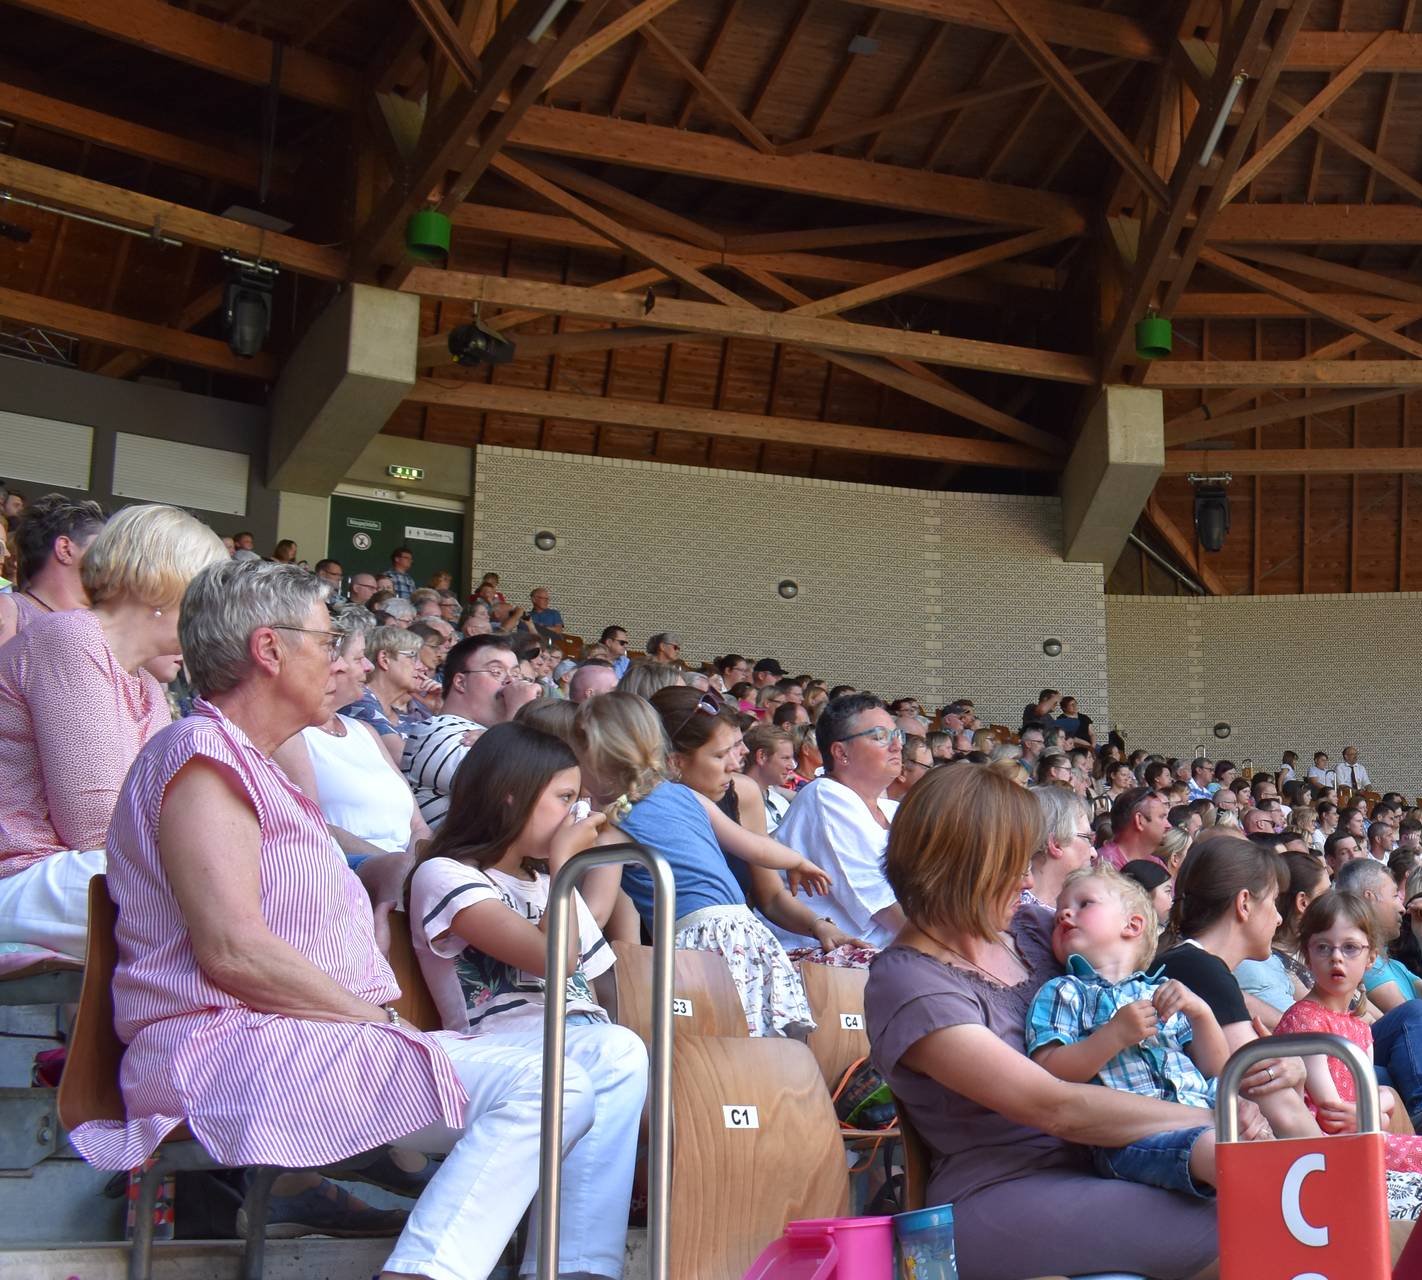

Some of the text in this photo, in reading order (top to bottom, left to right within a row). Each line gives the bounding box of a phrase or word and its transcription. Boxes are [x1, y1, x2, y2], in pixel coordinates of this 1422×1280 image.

[673, 1000, 687, 1014] C3
[845, 1016, 858, 1028] C4
[731, 1109, 750, 1126] C1
[1281, 1152, 1329, 1248] C
